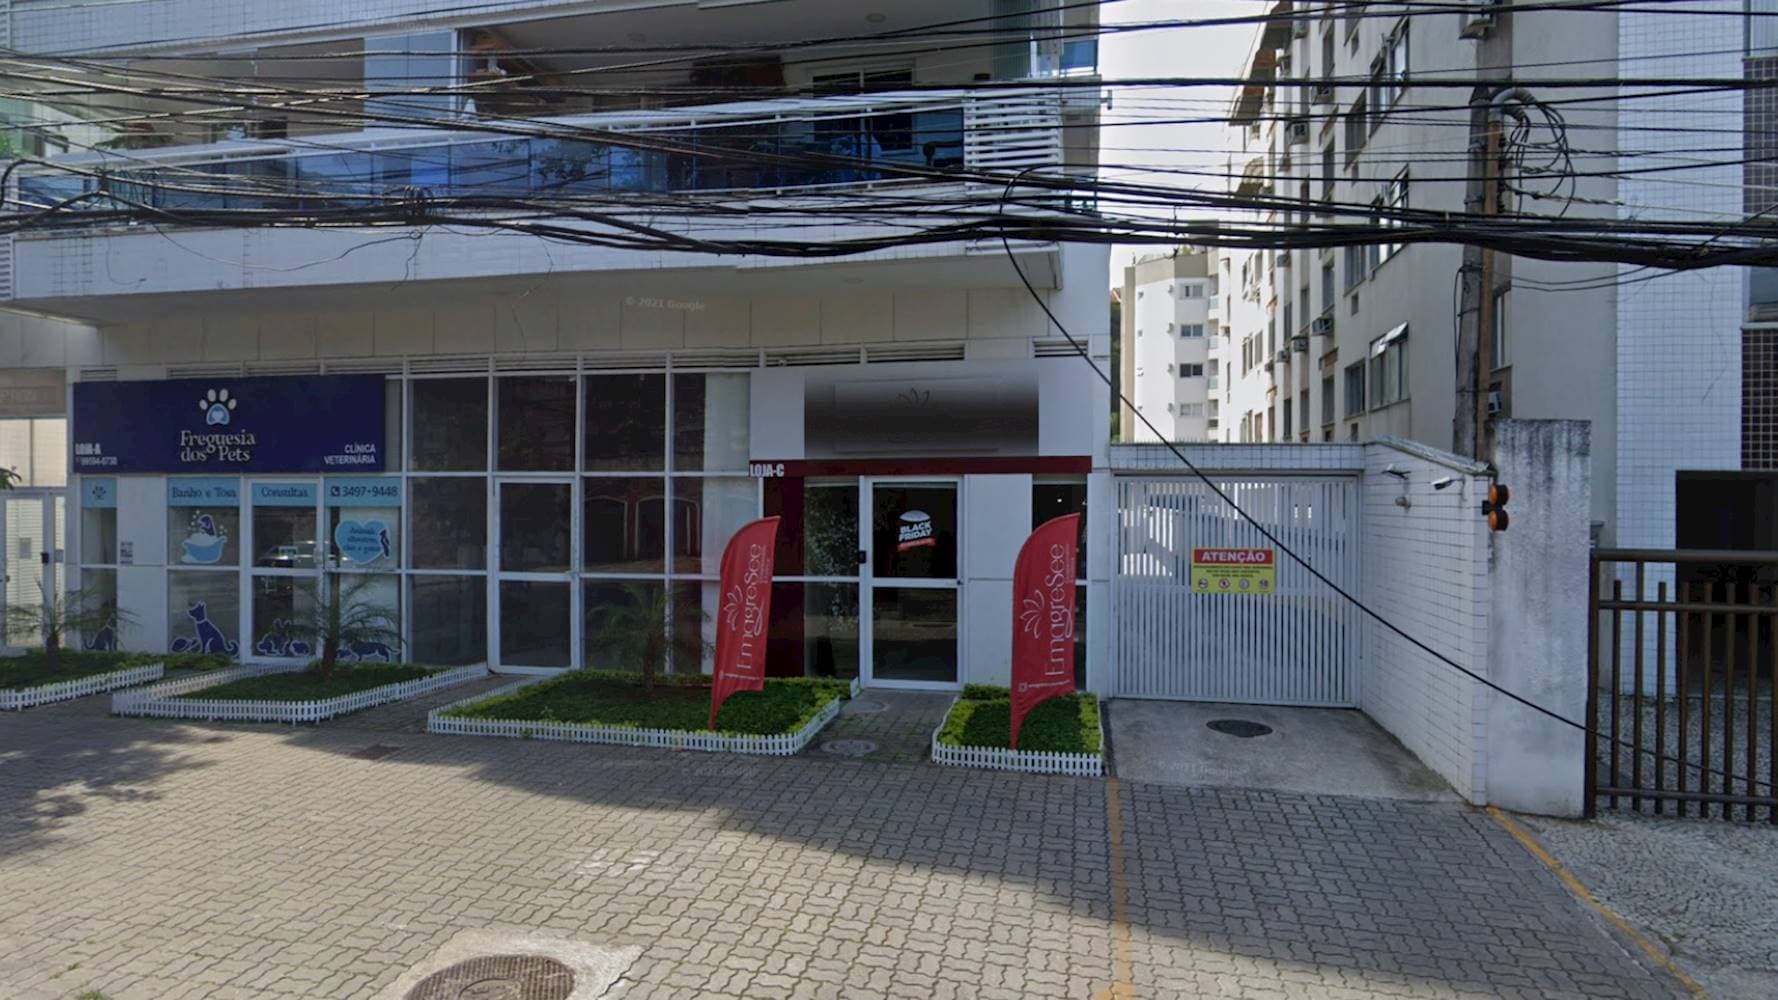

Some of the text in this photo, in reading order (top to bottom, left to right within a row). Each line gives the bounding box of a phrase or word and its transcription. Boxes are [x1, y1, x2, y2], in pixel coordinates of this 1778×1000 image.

[180, 429, 256, 453] Freguesia
[344, 441, 376, 454] CLÍNICA
[181, 445, 250, 461] dos Pets
[323, 453, 376, 465] VETERINÁRIA
[750, 463, 785, 478] LOJA-C
[172, 486, 202, 499] Banho
[261, 486, 309, 498] Consultas
[342, 486, 399, 497] 3497-9448
[901, 521, 932, 534] BLACK
[899, 529, 932, 542] FRIDAY
[1202, 550, 1266, 563] ATENÇÃO
[1044, 543, 1073, 677] EmagreSee
